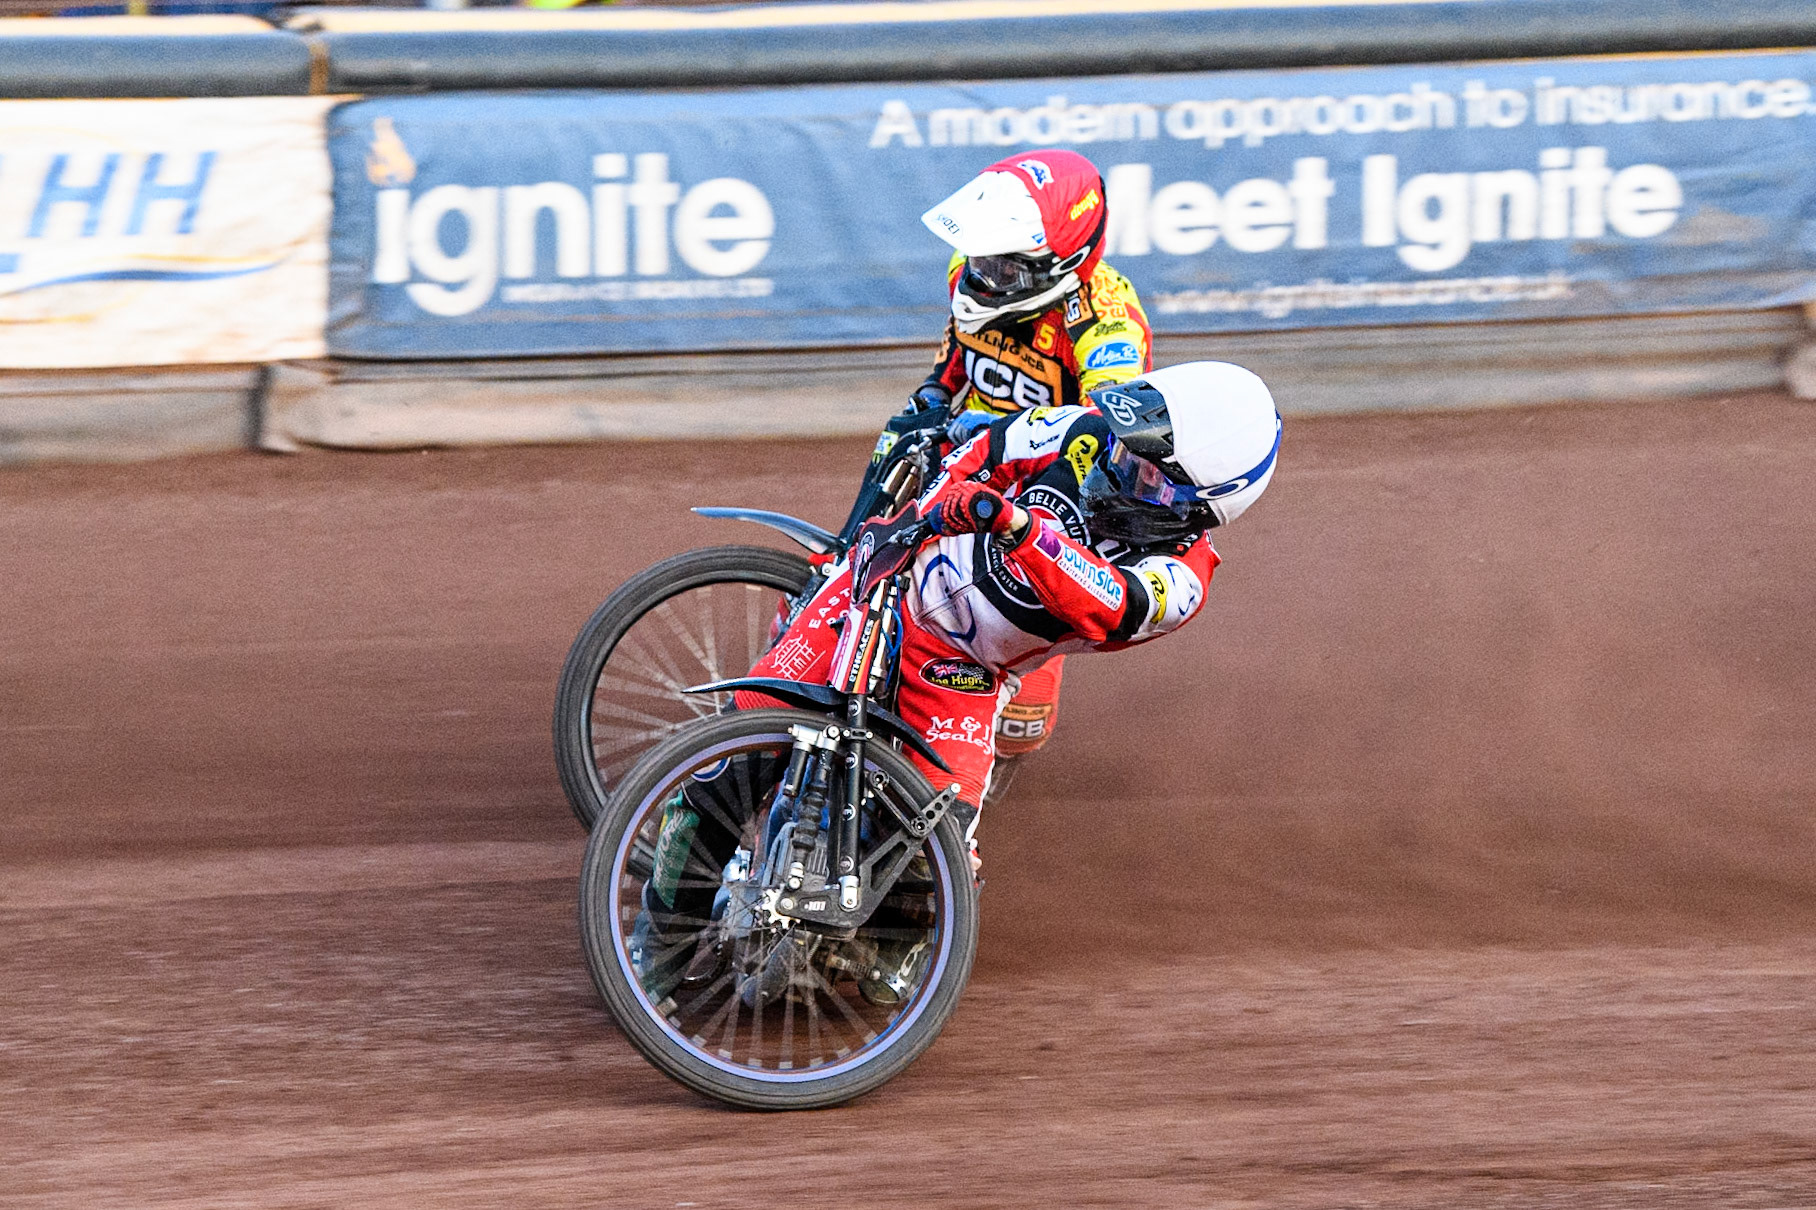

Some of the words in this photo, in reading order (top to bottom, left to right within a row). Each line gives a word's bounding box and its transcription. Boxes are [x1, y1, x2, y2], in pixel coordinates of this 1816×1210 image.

[869, 100, 923, 148] A
[1165, 82, 1456, 149] approach
[1463, 78, 1528, 128] to
[1362, 146, 1684, 273] Ignite
[372, 151, 777, 317] ignite
[1036, 322, 1056, 350] 5
[1028, 492, 1068, 516] BELLE
[808, 587, 850, 630] EAST
[930, 716, 956, 730] M
[960, 716, 982, 732] &
[925, 729, 993, 755] Sealey
